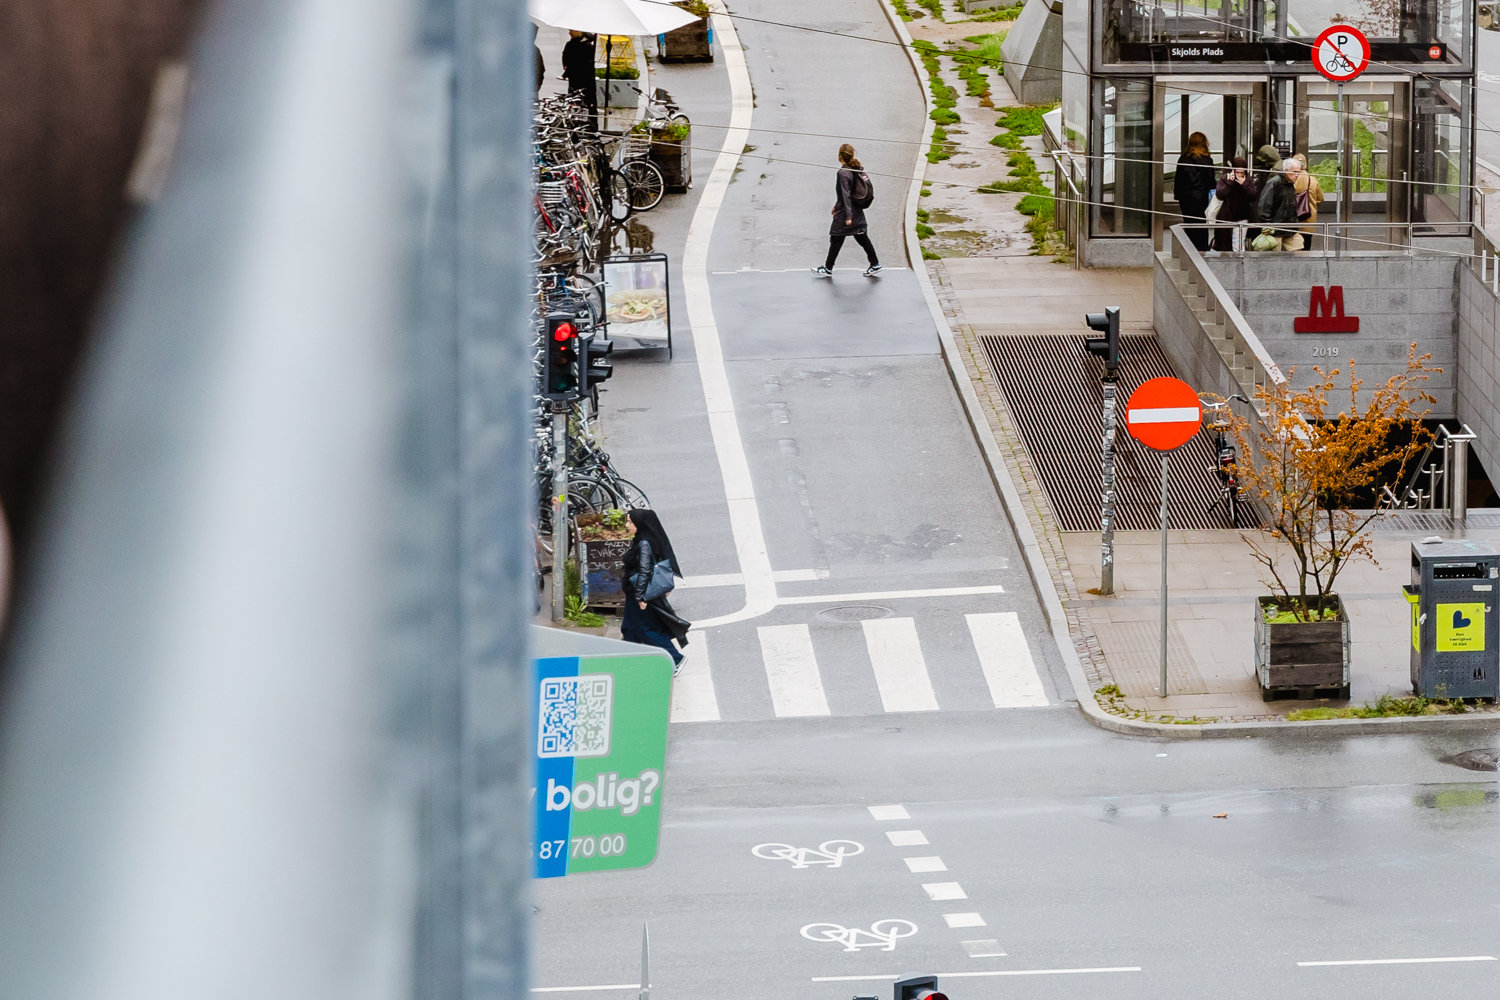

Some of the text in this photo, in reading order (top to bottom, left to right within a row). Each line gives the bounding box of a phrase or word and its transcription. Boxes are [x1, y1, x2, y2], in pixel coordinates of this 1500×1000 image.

[1337, 35, 1348, 45] P
[1171, 47, 1224, 58] Skjolds Plads
[1312, 347, 1339, 358] 2019
[546, 771, 659, 814] bolig?
[539, 840, 565, 860] 87
[571, 837, 595, 857] 70
[599, 834, 625, 855] 00
